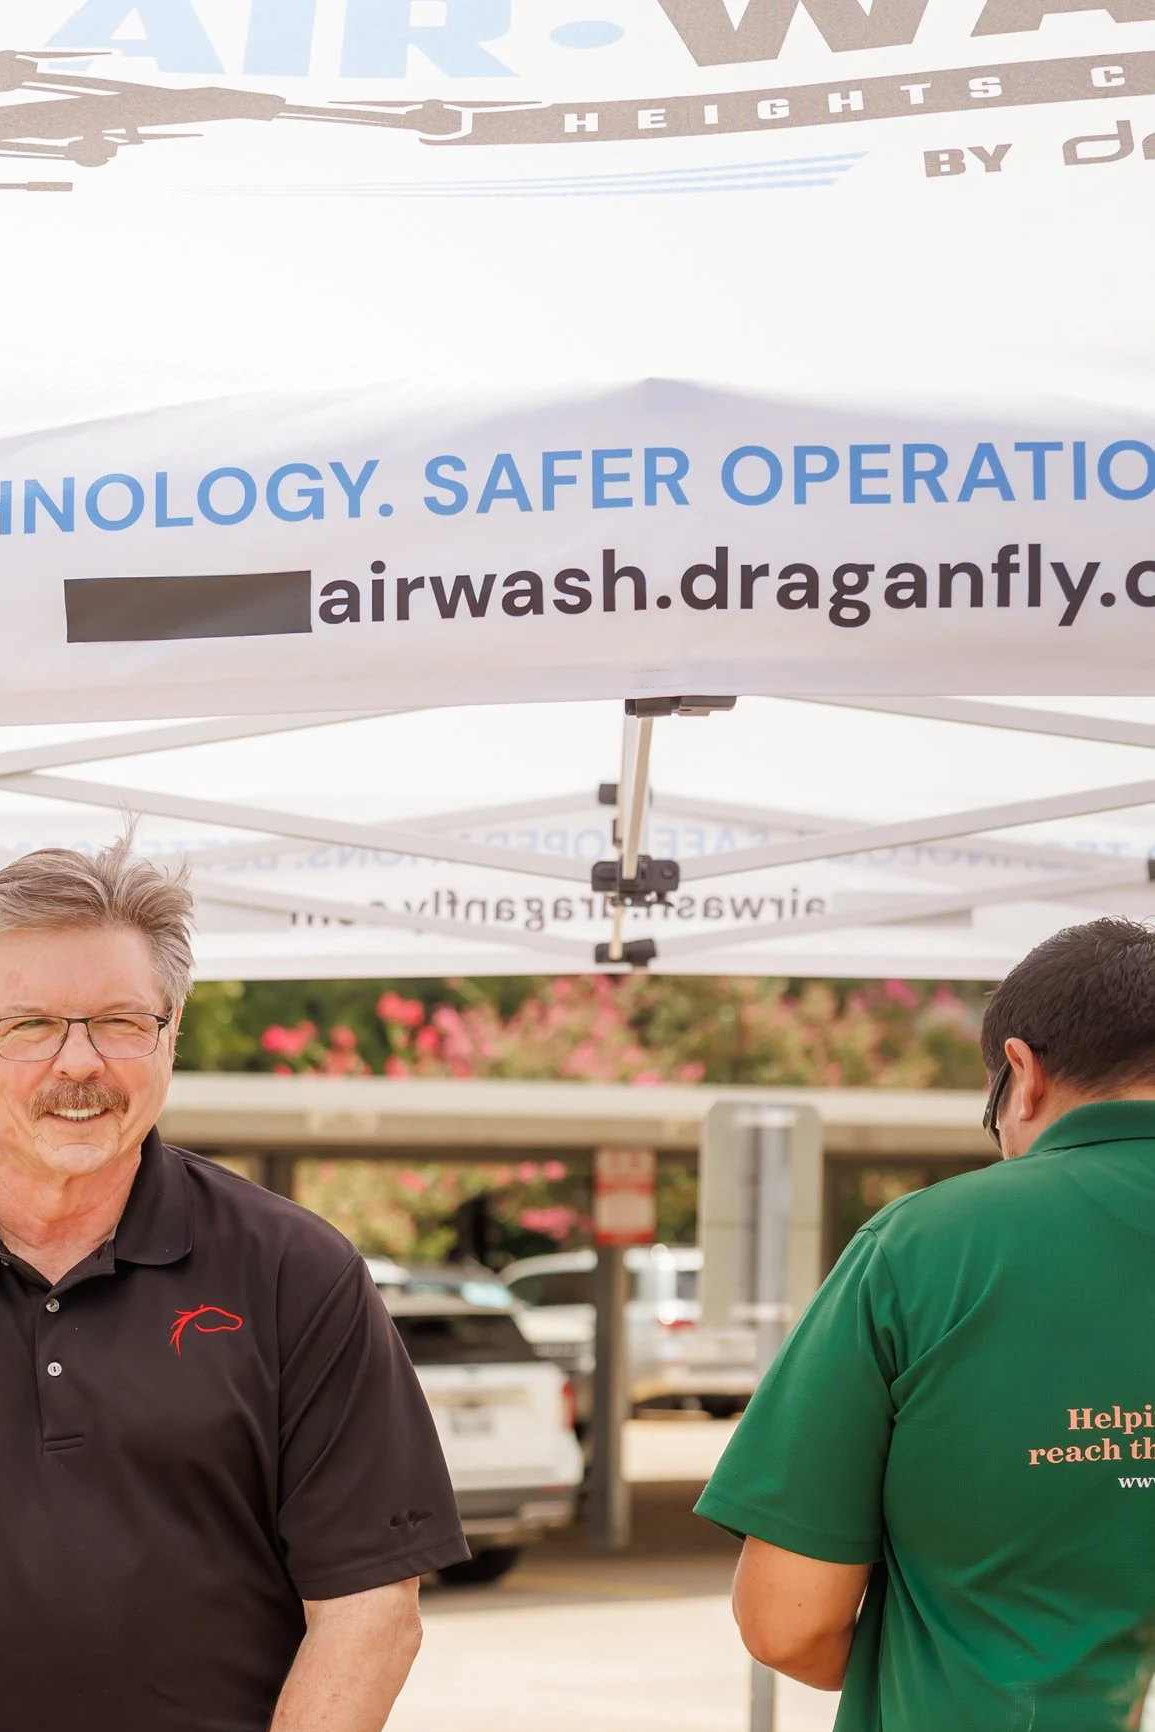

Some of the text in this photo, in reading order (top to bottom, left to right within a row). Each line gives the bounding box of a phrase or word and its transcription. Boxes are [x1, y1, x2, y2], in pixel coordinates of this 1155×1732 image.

[563, 76, 1003, 134] HEIGHTS
[923, 143, 1013, 179] BY
[423, 446, 691, 518] SAFER
[720, 439, 1155, 507] OPERATIO
[1028, 1437, 1123, 1466] reach
